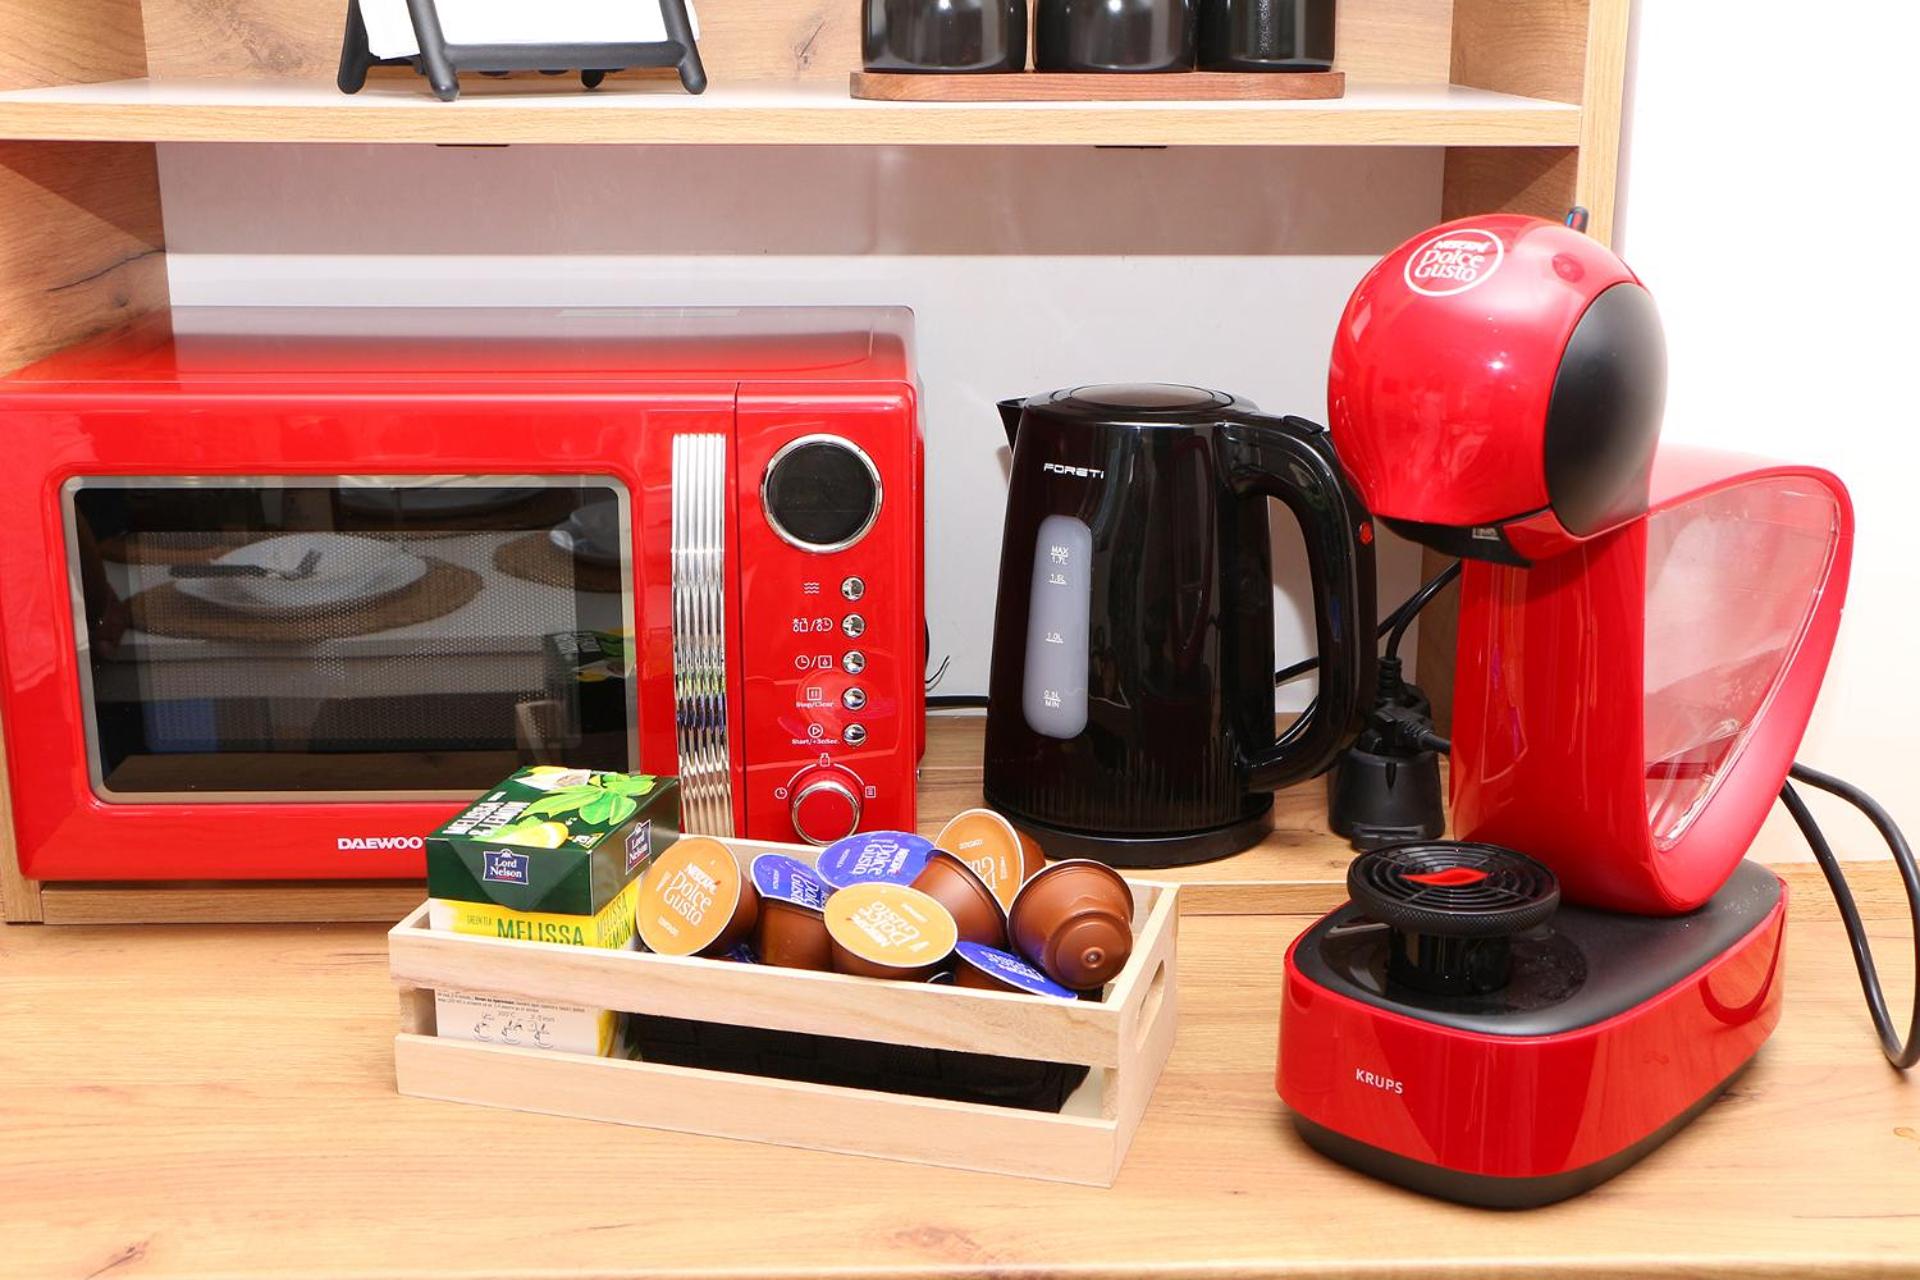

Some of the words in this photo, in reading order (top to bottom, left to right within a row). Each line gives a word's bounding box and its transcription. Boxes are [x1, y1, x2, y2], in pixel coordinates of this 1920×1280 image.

[1419, 249, 1485, 269] Dolce
[1414, 263, 1477, 281] Gusto
[1043, 462, 1105, 480] FORETI
[337, 836, 424, 850] DAEWOO
[494, 857, 517, 868] Lord
[849, 843, 882, 875] Gusto
[868, 844, 899, 875] Dolce
[490, 865, 522, 878] Nelson
[669, 869, 712, 913] Dolce
[663, 887, 703, 926] Gusto
[1356, 1068, 1404, 1095] KRUPS
